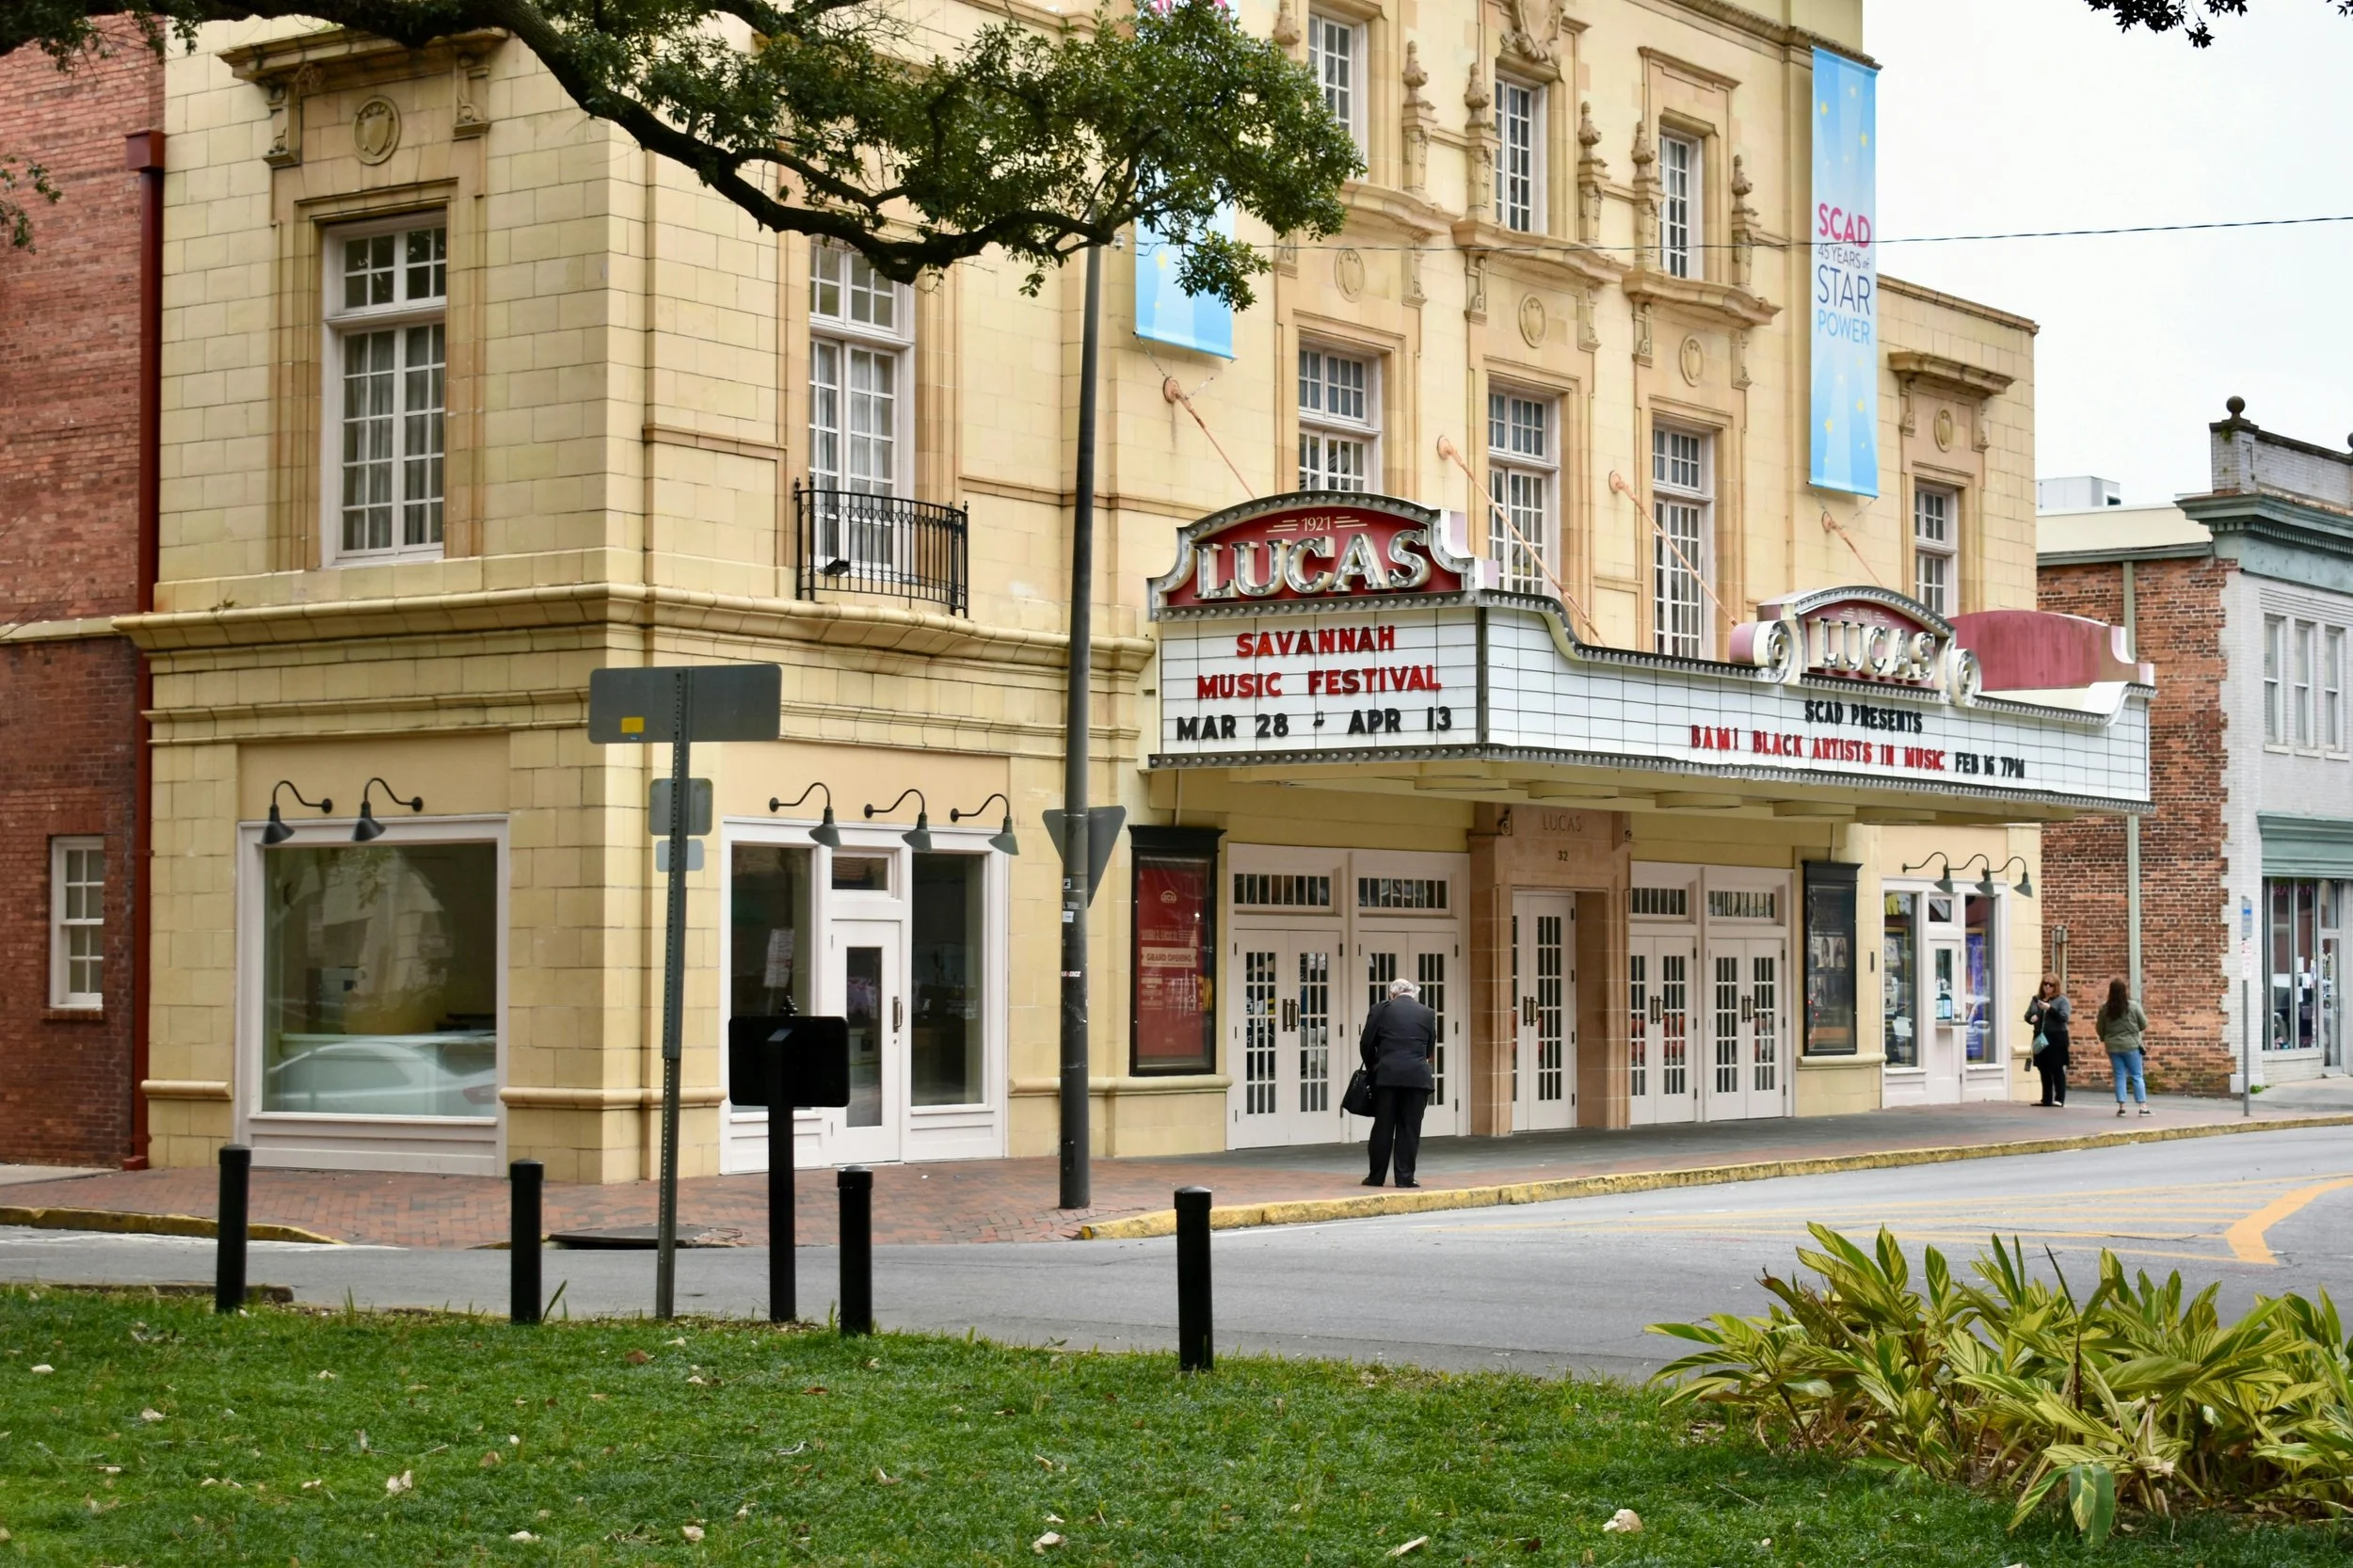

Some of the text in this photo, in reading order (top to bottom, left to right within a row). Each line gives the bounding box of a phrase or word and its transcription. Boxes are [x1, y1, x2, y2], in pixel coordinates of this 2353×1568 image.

[1818, 202, 1871, 248] SCAD
[1817, 244, 1830, 260] 45
[1832, 246, 1861, 269] YEARS
[1817, 264, 1871, 315] STAR
[1817, 309, 1870, 345] POWER
[1301, 516, 1331, 532] 1921
[1193, 529, 1432, 600] LUCAS
[1236, 626, 1395, 658] SAVANNAH
[1807, 616, 1936, 681] LUCAS
[1196, 665, 1442, 700] MUSIC FESTIVAL
[1176, 714, 1237, 741] MAR
[1256, 713, 1289, 738] 28
[1347, 708, 1401, 734] APR
[1427, 706, 1452, 731] 13
[1804, 699, 1923, 734] SCAD PRESENTS
[1691, 725, 2025, 779] BAM! BLACK ARTISTS IN MUSIC FEB 16 7PM
[1543, 813, 1582, 833] LUCAS
[1558, 850, 1568, 862] 32
